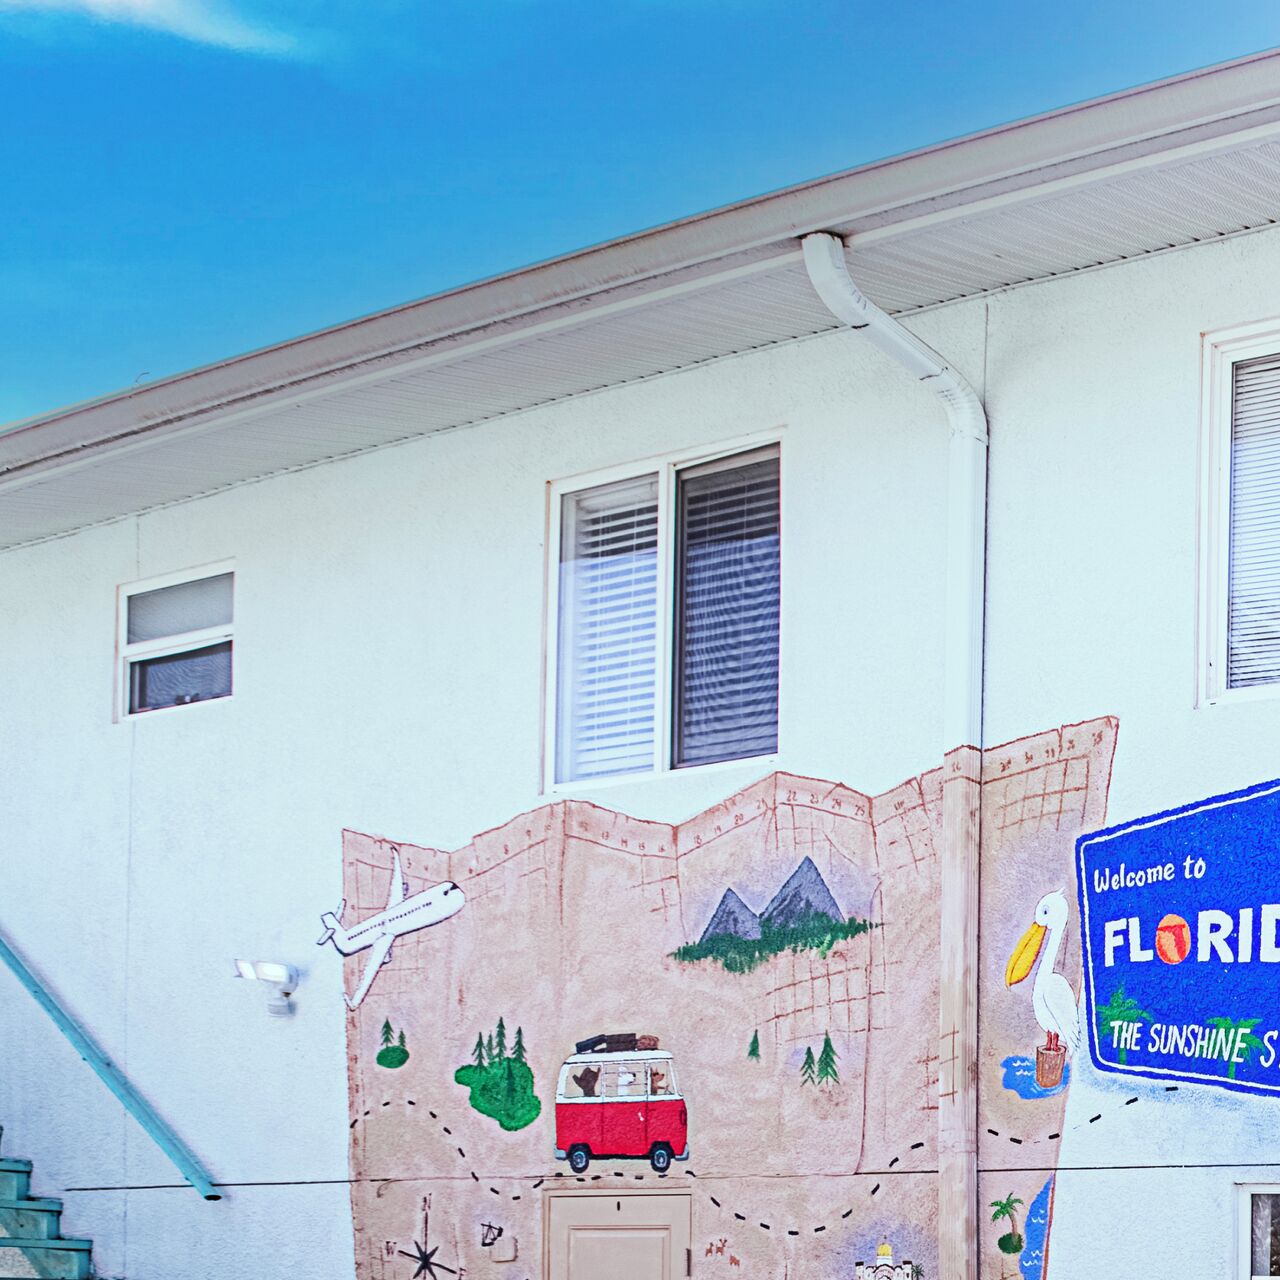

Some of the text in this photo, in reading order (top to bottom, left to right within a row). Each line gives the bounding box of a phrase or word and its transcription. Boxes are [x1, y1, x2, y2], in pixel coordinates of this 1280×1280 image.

[1093, 855, 1206, 894] Welcome to
[1109, 1020, 1141, 1051] THE
[1148, 1022, 1251, 1063] SUNSHINE
